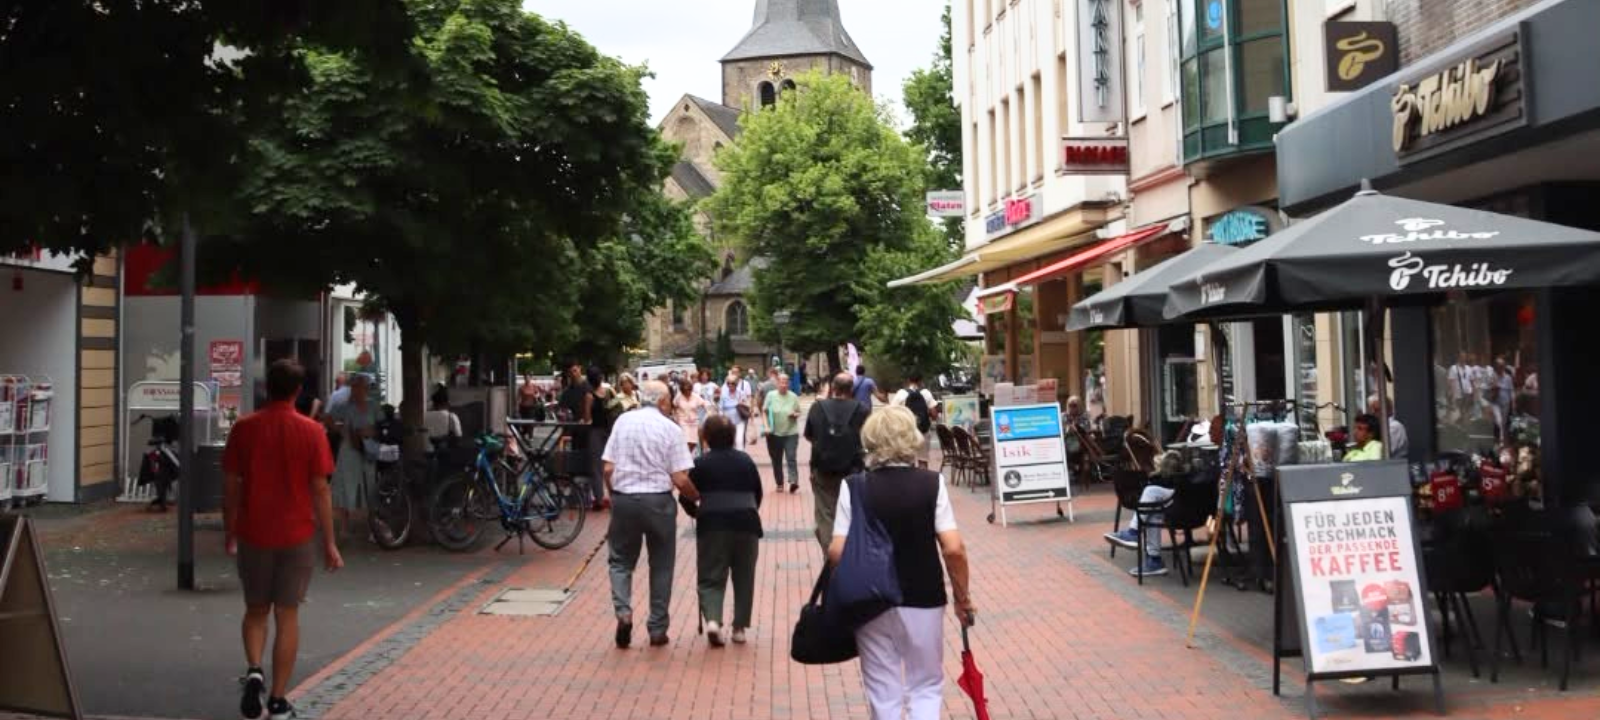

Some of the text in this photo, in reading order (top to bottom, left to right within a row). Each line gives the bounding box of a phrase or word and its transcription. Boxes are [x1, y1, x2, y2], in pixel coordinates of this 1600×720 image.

[1417, 58, 1499, 135] Tchibo
[1359, 230, 1500, 244] Tchibo
[1423, 263, 1513, 288] Tchibo
[1304, 510, 1395, 529] FÜR JEDEN
[1307, 526, 1397, 543] GESCHMACK
[1309, 539, 1399, 555] DER PASSENDE
[1310, 551, 1402, 576] KAFFEE
